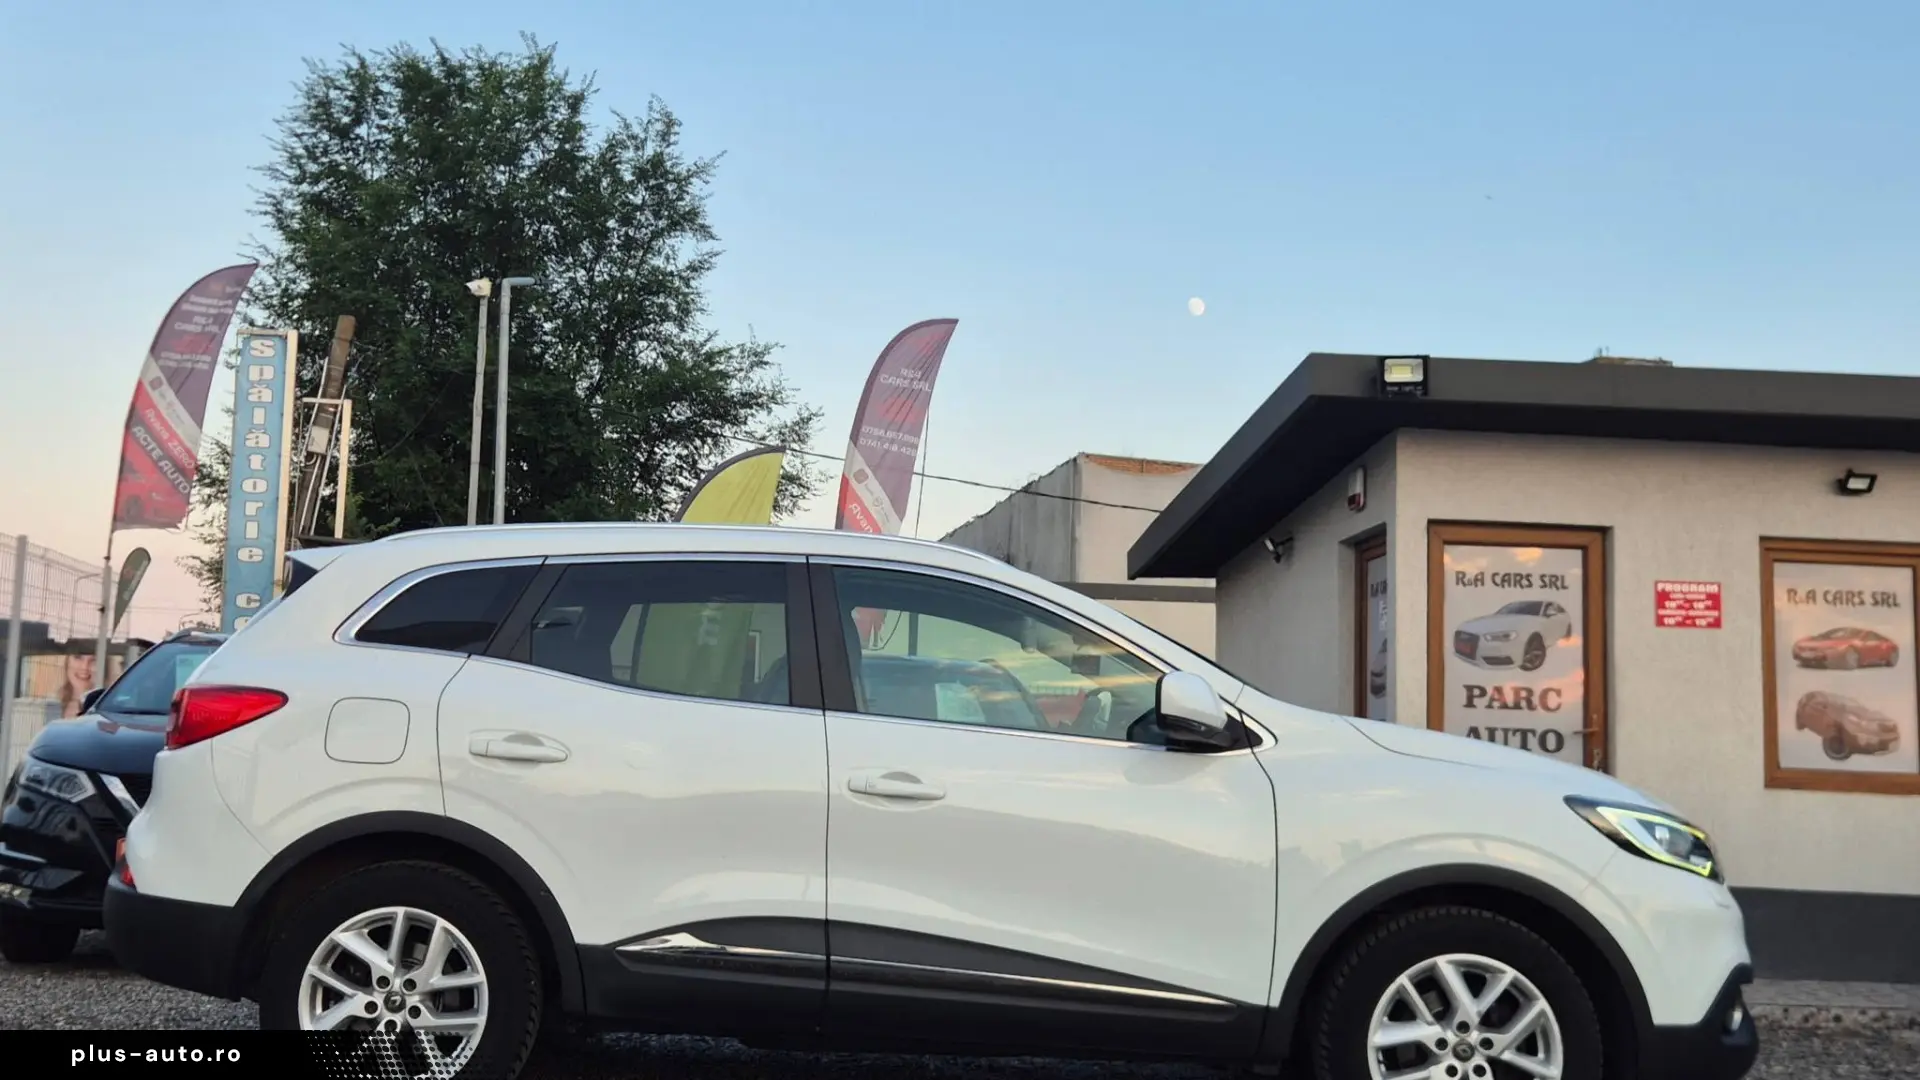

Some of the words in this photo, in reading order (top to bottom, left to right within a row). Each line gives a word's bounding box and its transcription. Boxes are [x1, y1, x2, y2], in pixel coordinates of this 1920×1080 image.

[880, 373, 909, 388] CARS
[158, 460, 191, 494] AUTO
[1491, 572, 1533, 589] CARS
[1539, 573, 1569, 591] SRL
[1657, 582, 1719, 593] PROGRAM
[1823, 589, 1865, 607] CARS
[1869, 590, 1901, 608] SRL
[1462, 684, 1562, 713] PARC
